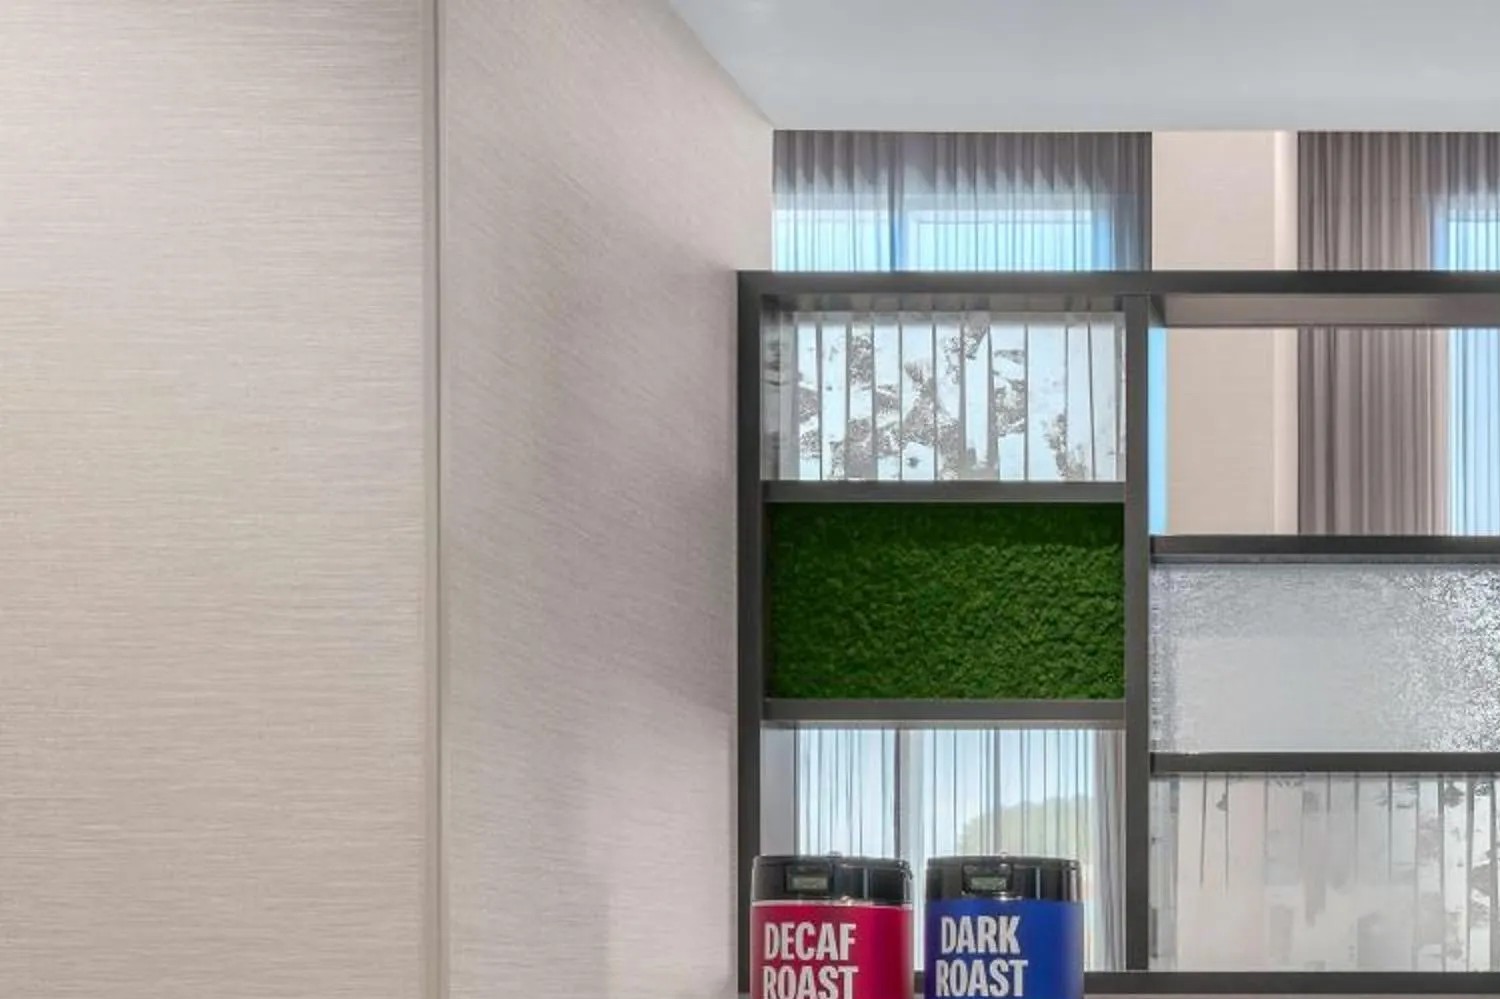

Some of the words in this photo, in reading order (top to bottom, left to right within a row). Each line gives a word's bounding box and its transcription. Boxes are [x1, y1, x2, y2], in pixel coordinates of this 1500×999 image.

[764, 921, 857, 961] DECAF
[941, 915, 1021, 954] DARK
[936, 959, 1029, 997] ROAST
